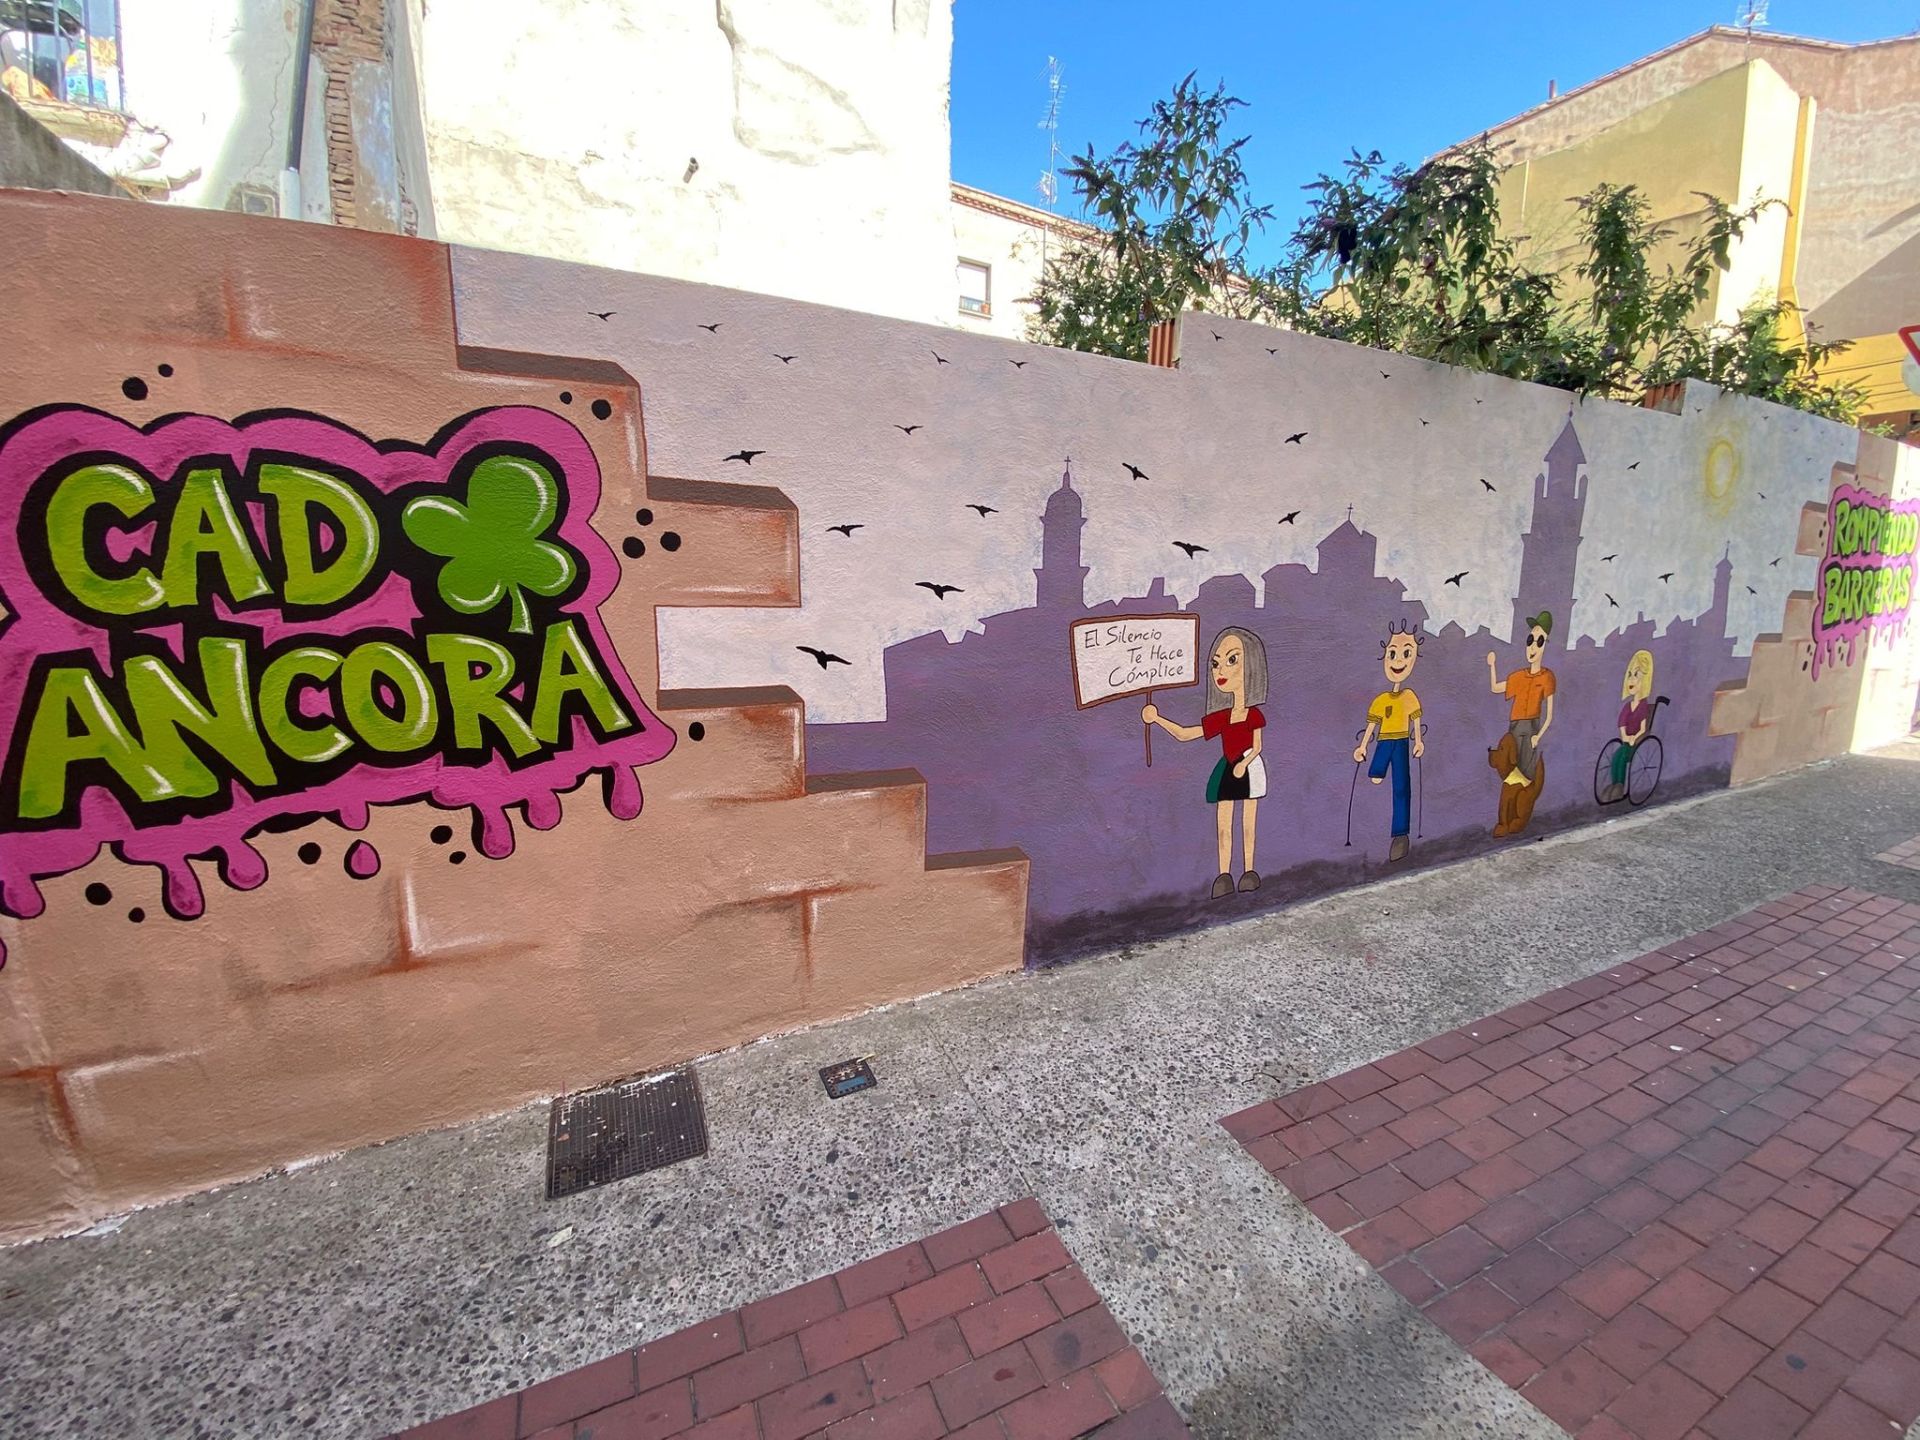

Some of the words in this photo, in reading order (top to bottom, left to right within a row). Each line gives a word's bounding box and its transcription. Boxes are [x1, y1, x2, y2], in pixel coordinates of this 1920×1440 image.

[45, 463, 381, 615] CAD
[1822, 565, 1913, 626] BARRERAS
[1084, 628, 1100, 649] El
[1105, 624, 1162, 646] Silencio
[1126, 646, 1143, 664] Te
[1150, 644, 1184, 661] Hace
[1108, 661, 1184, 687] Cómplice
[17, 618, 633, 819] ANCORA
